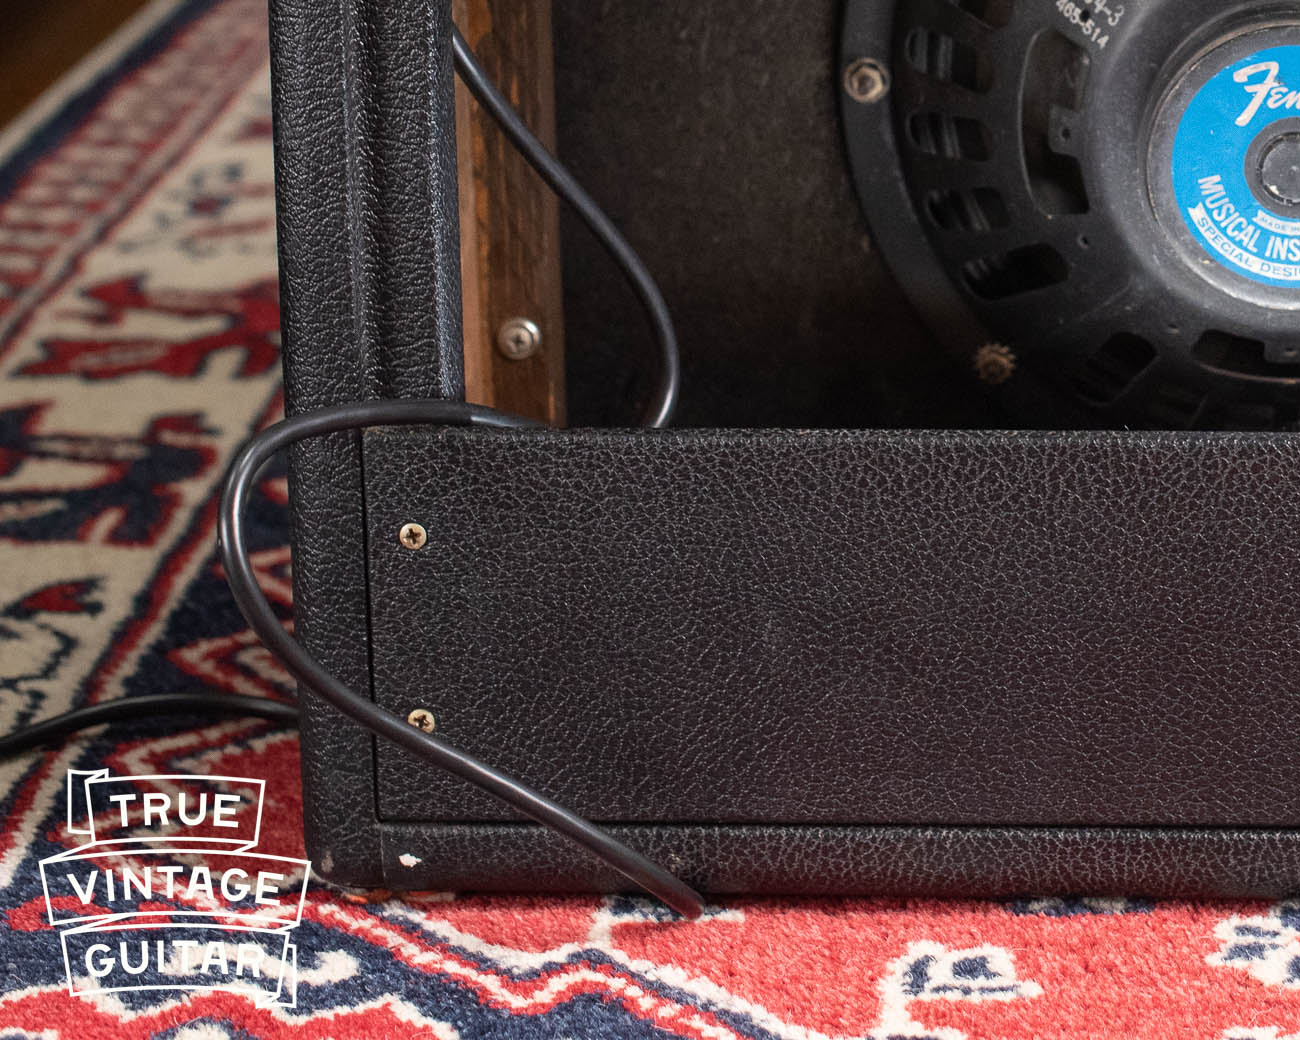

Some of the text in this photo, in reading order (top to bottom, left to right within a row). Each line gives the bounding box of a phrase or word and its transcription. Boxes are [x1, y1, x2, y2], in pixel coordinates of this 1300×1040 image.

[1198, 174, 1261, 253] MUSICAL
[1261, 217, 1287, 231] MADE
[1196, 216, 1255, 268] SPECIAL
